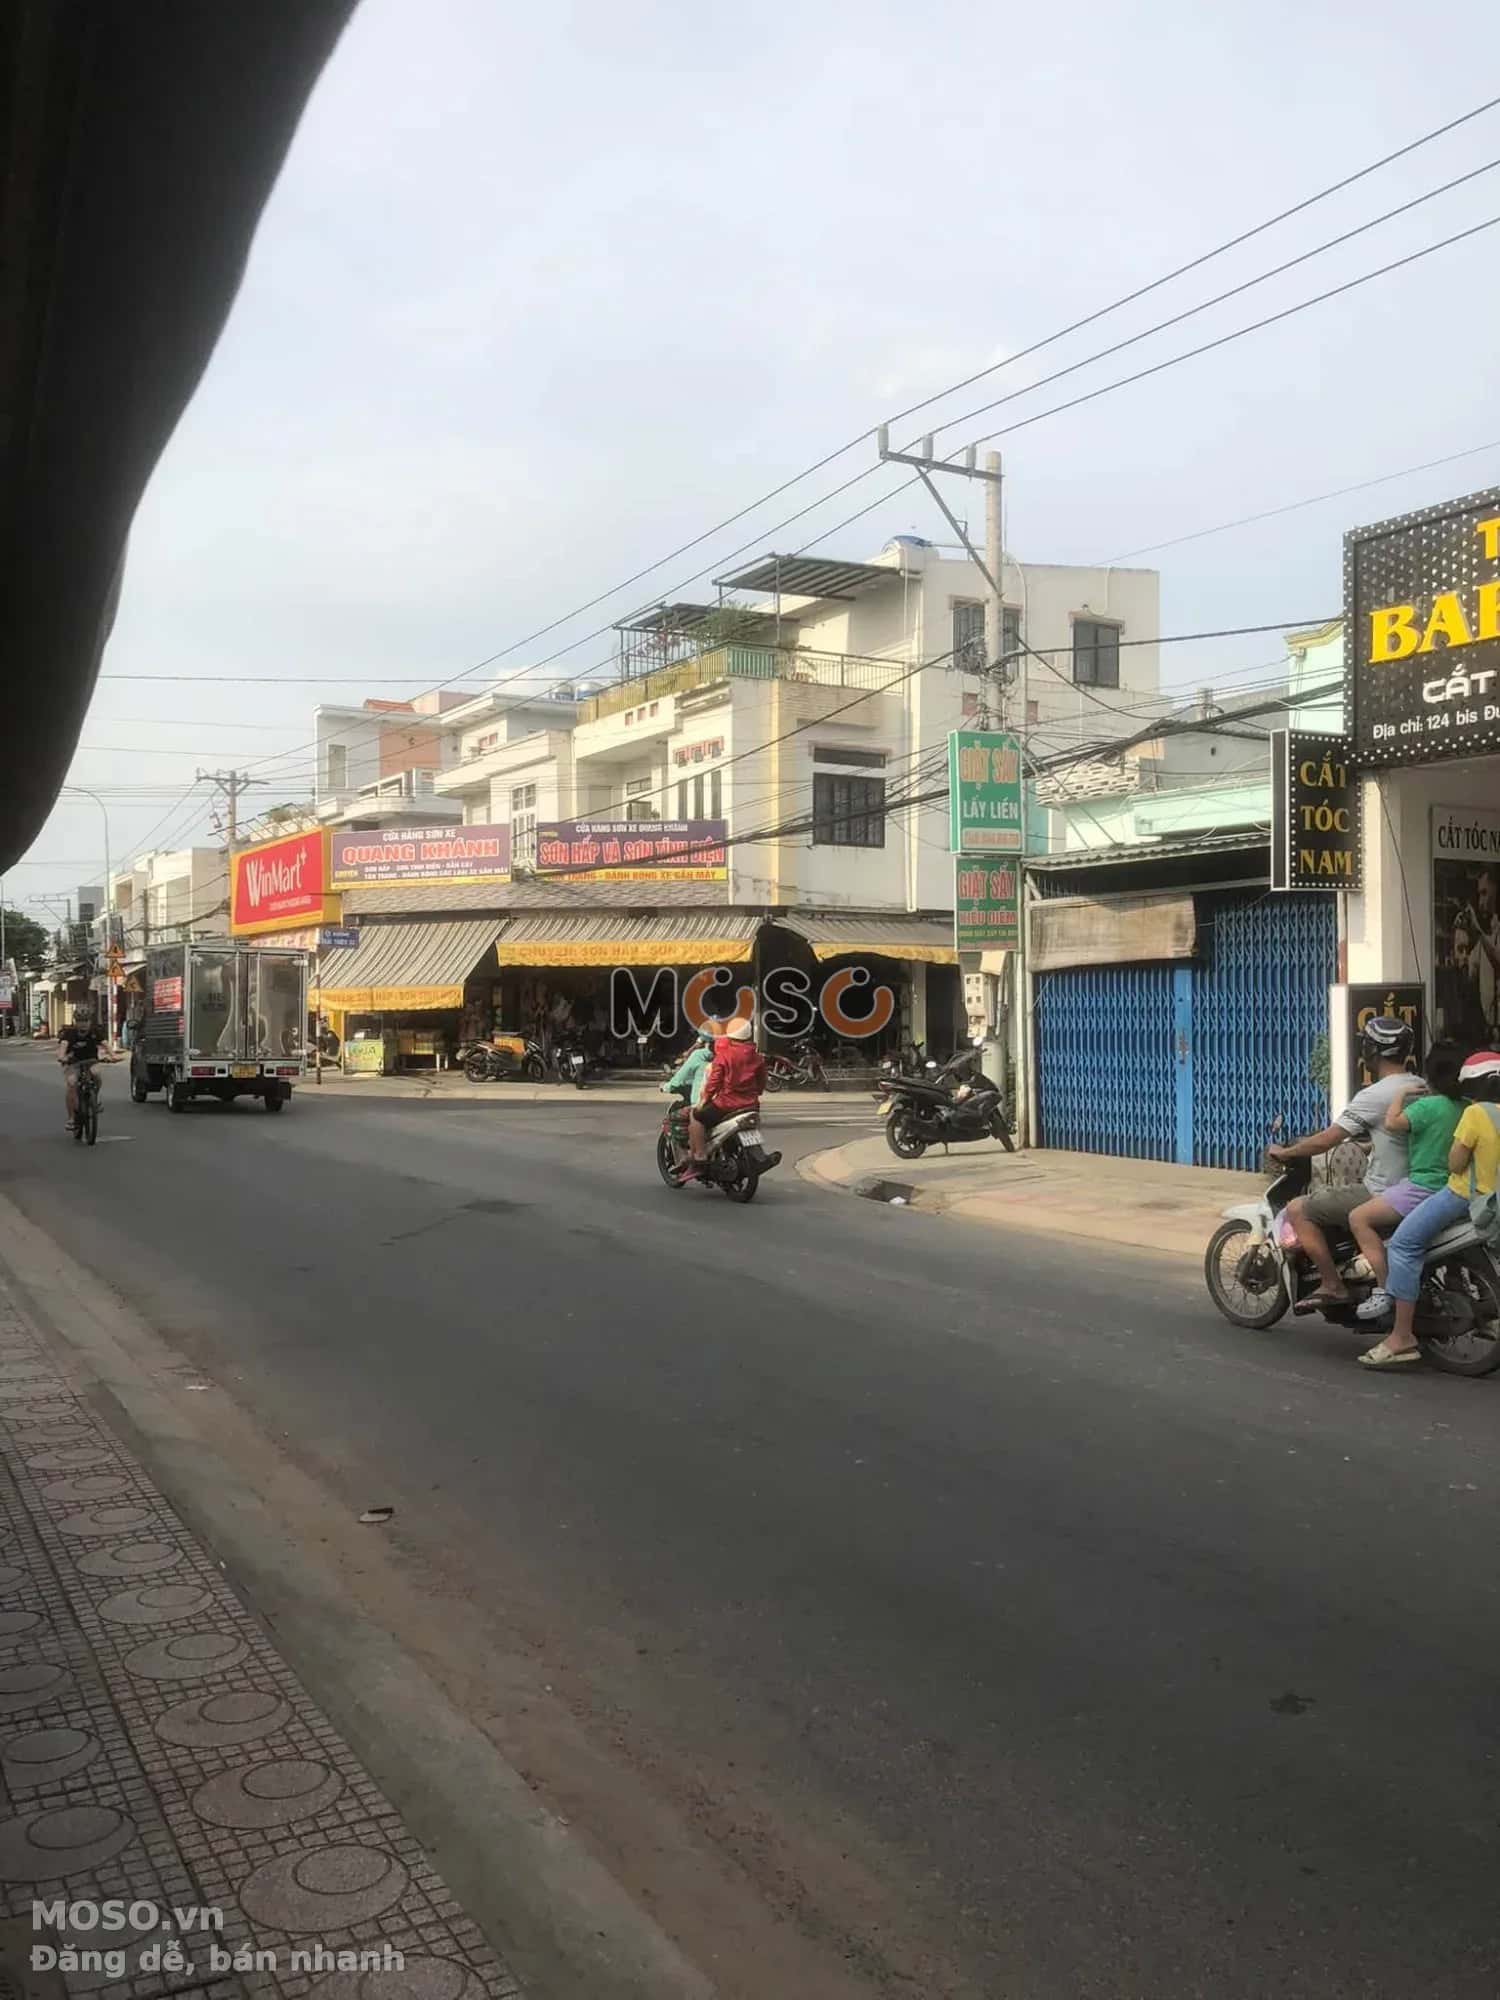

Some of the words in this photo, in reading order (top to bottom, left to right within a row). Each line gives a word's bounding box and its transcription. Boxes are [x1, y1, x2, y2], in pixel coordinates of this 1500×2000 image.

[1422, 663, 1498, 703] CẮT
[1372, 722, 1395, 741] Địa
[1426, 712, 1449, 730] 124
[1456, 708, 1478, 726] bis
[1300, 798, 1351, 833] TÓC
[342, 843, 416, 866] QUANG
[420, 836, 499, 861] KHÁNH
[540, 839, 570, 865] SƠN
[602, 837, 622, 864] VÀ
[1299, 850, 1352, 877] NAM
